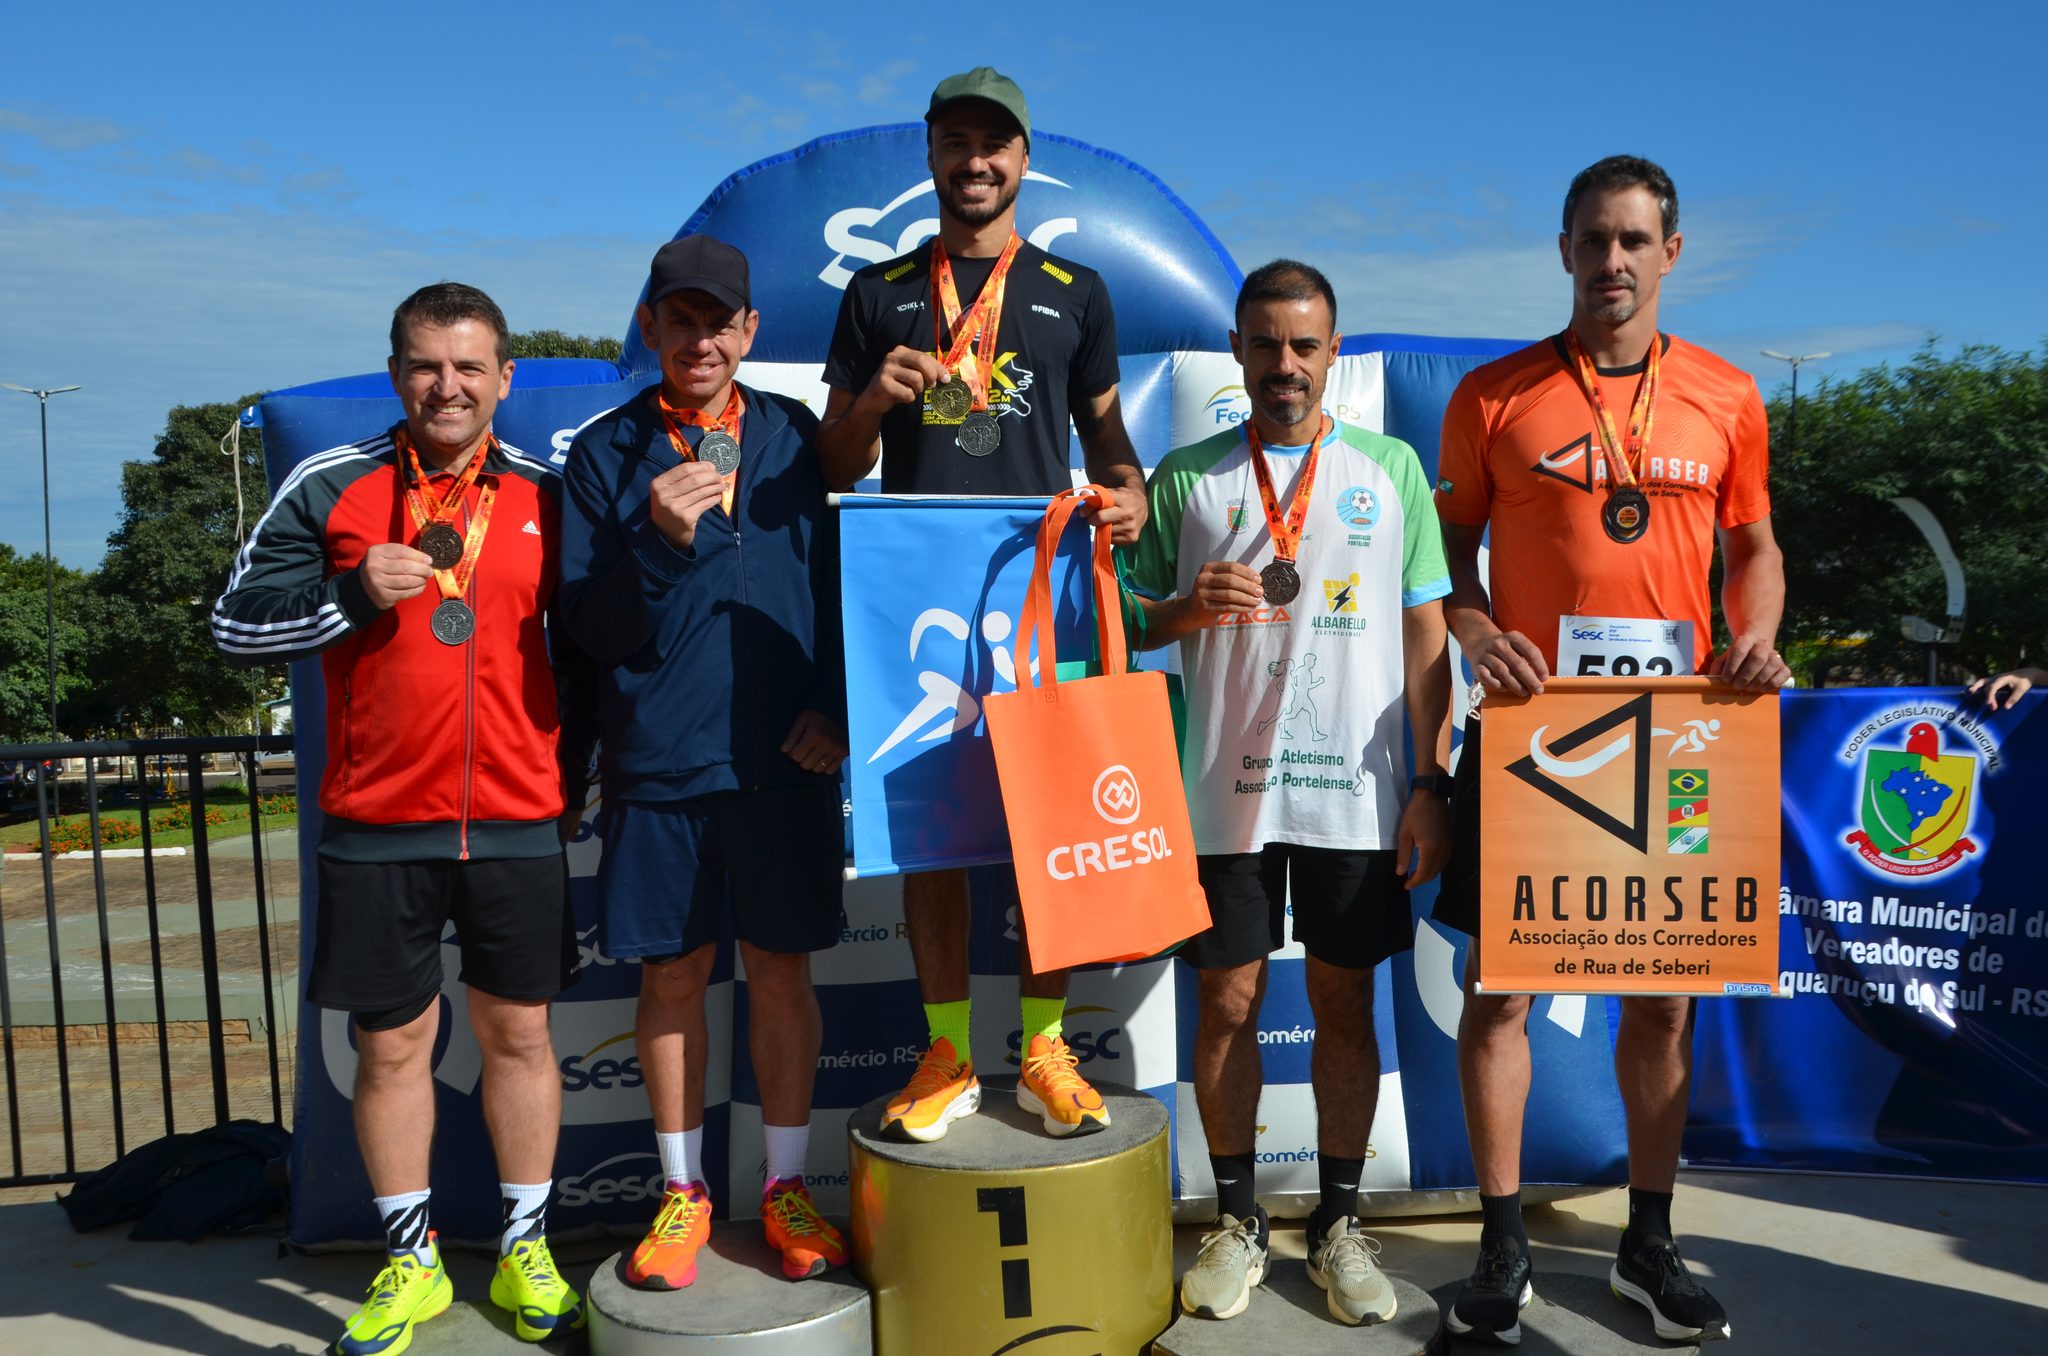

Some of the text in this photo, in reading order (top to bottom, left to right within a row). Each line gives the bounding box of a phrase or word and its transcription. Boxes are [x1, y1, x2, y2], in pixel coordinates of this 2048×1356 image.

[817, 207, 1077, 290] sc
[1038, 305, 1060, 319] FIBRA
[1337, 404, 1361, 420] RS
[1311, 616, 1366, 630] ALBARELLO
[1572, 629, 1604, 640] sesc
[1844, 707, 2000, 770] PODER LEGISLATIVO MUNICIPAL
[1242, 749, 1344, 772] Grupo Atletismo
[1282, 772, 1353, 790] Portelense
[1046, 826, 1172, 880] CRESOL
[1512, 875, 1757, 923] ACORSEB
[1779, 886, 2048, 939] âmara Municipal d
[1509, 928, 1757, 949] Associação dos Corredores
[1804, 928, 2004, 974] Vereadores de
[1554, 957, 1710, 976] de Rua de Seberi
[1726, 984, 1769, 993] prisma
[1779, 971, 1895, 1007] quaruçu
[1941, 981, 1984, 1011] Sul
[2011, 988, 2048, 1018] RS
[817, 1050, 887, 1068] mércio
[1004, 1028, 1120, 1067] ssc
[560, 1055, 645, 1092] ses
